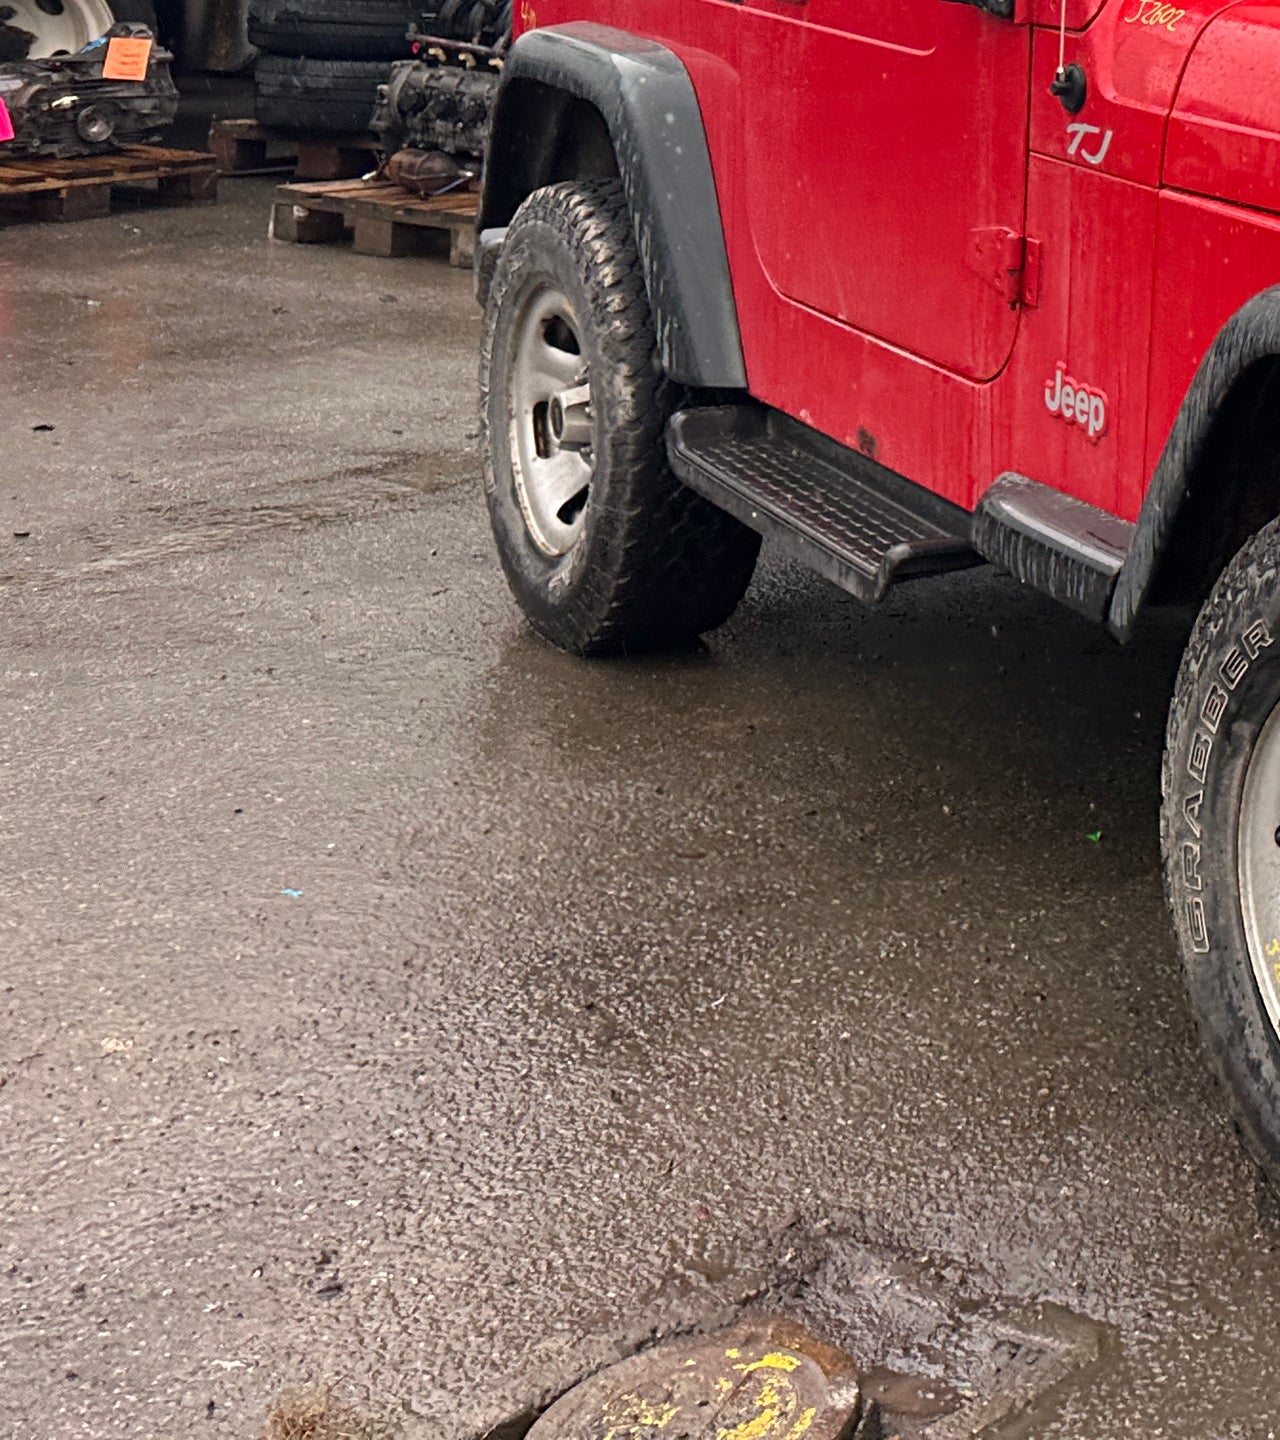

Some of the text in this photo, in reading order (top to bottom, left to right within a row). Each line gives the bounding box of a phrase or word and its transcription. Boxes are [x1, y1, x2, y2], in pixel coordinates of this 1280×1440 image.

[1065, 122, 1113, 165] TJ
[1044, 364, 1107, 436] Jeep
[1185, 619, 1273, 954] GRABBER
